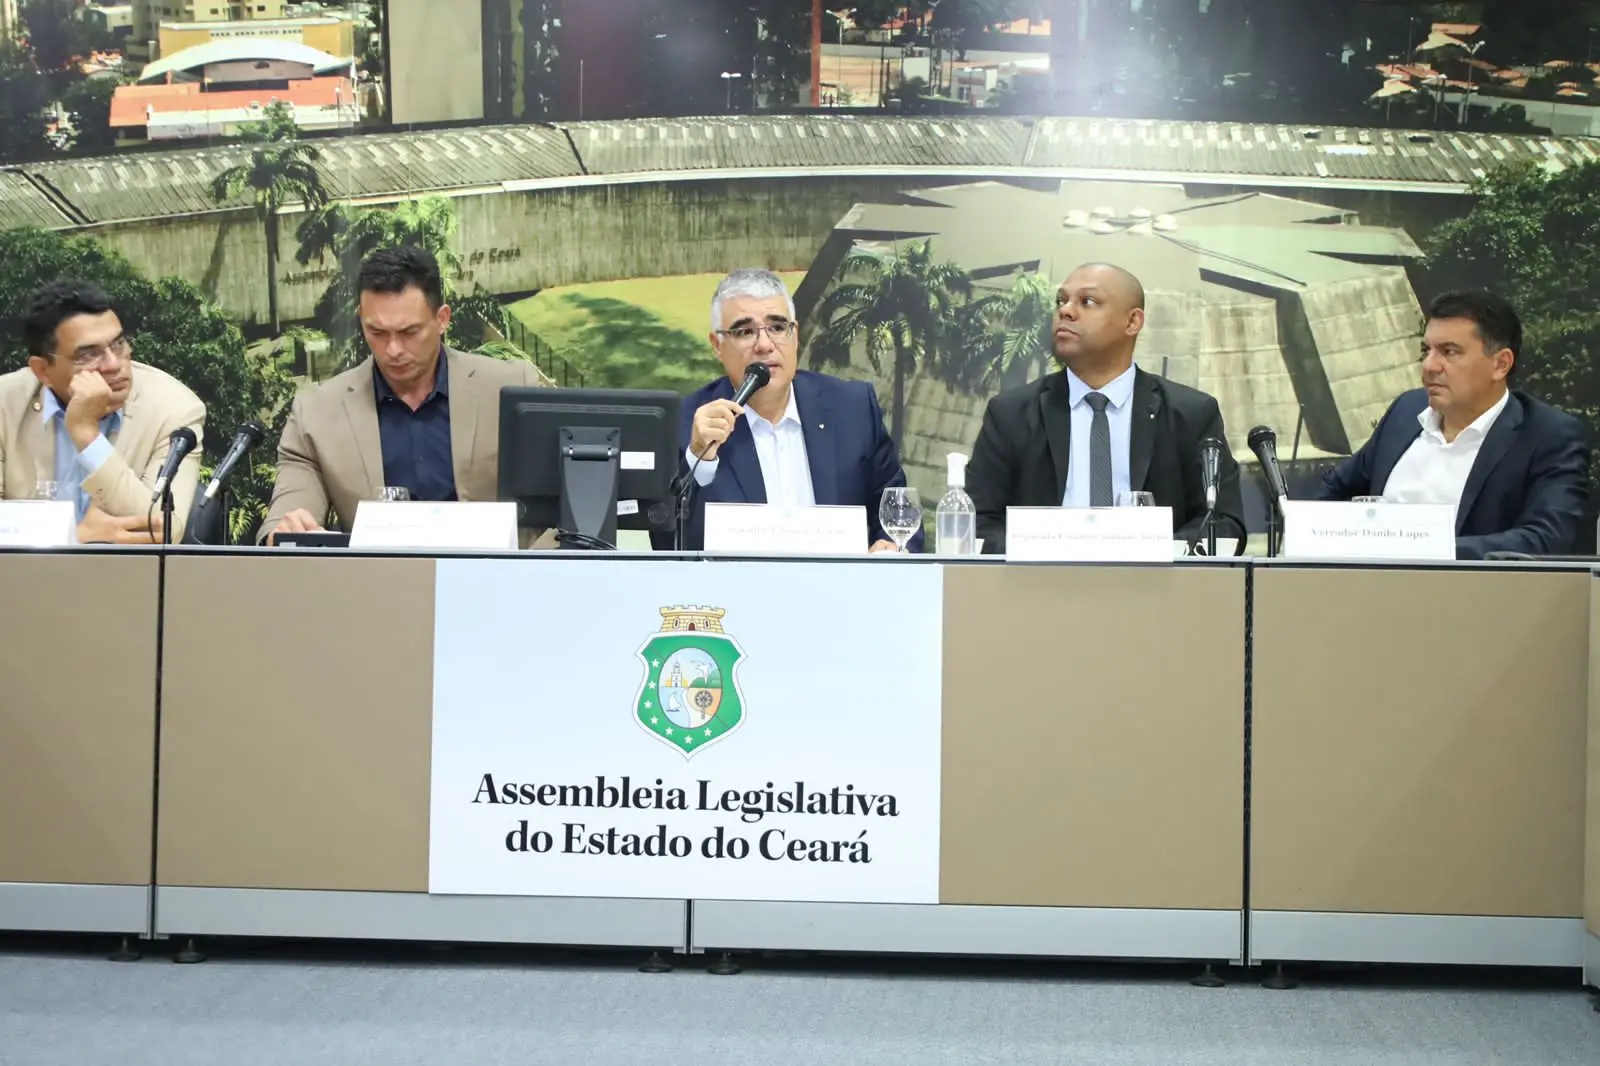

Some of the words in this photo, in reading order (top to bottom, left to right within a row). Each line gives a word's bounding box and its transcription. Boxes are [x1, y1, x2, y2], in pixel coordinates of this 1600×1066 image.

[471, 773, 689, 811] Assembleia
[696, 780, 899, 824] Legislativa
[505, 819, 553, 853] do
[562, 822, 692, 858] Estado
[700, 826, 750, 860] do
[759, 829, 872, 864] Ceará
